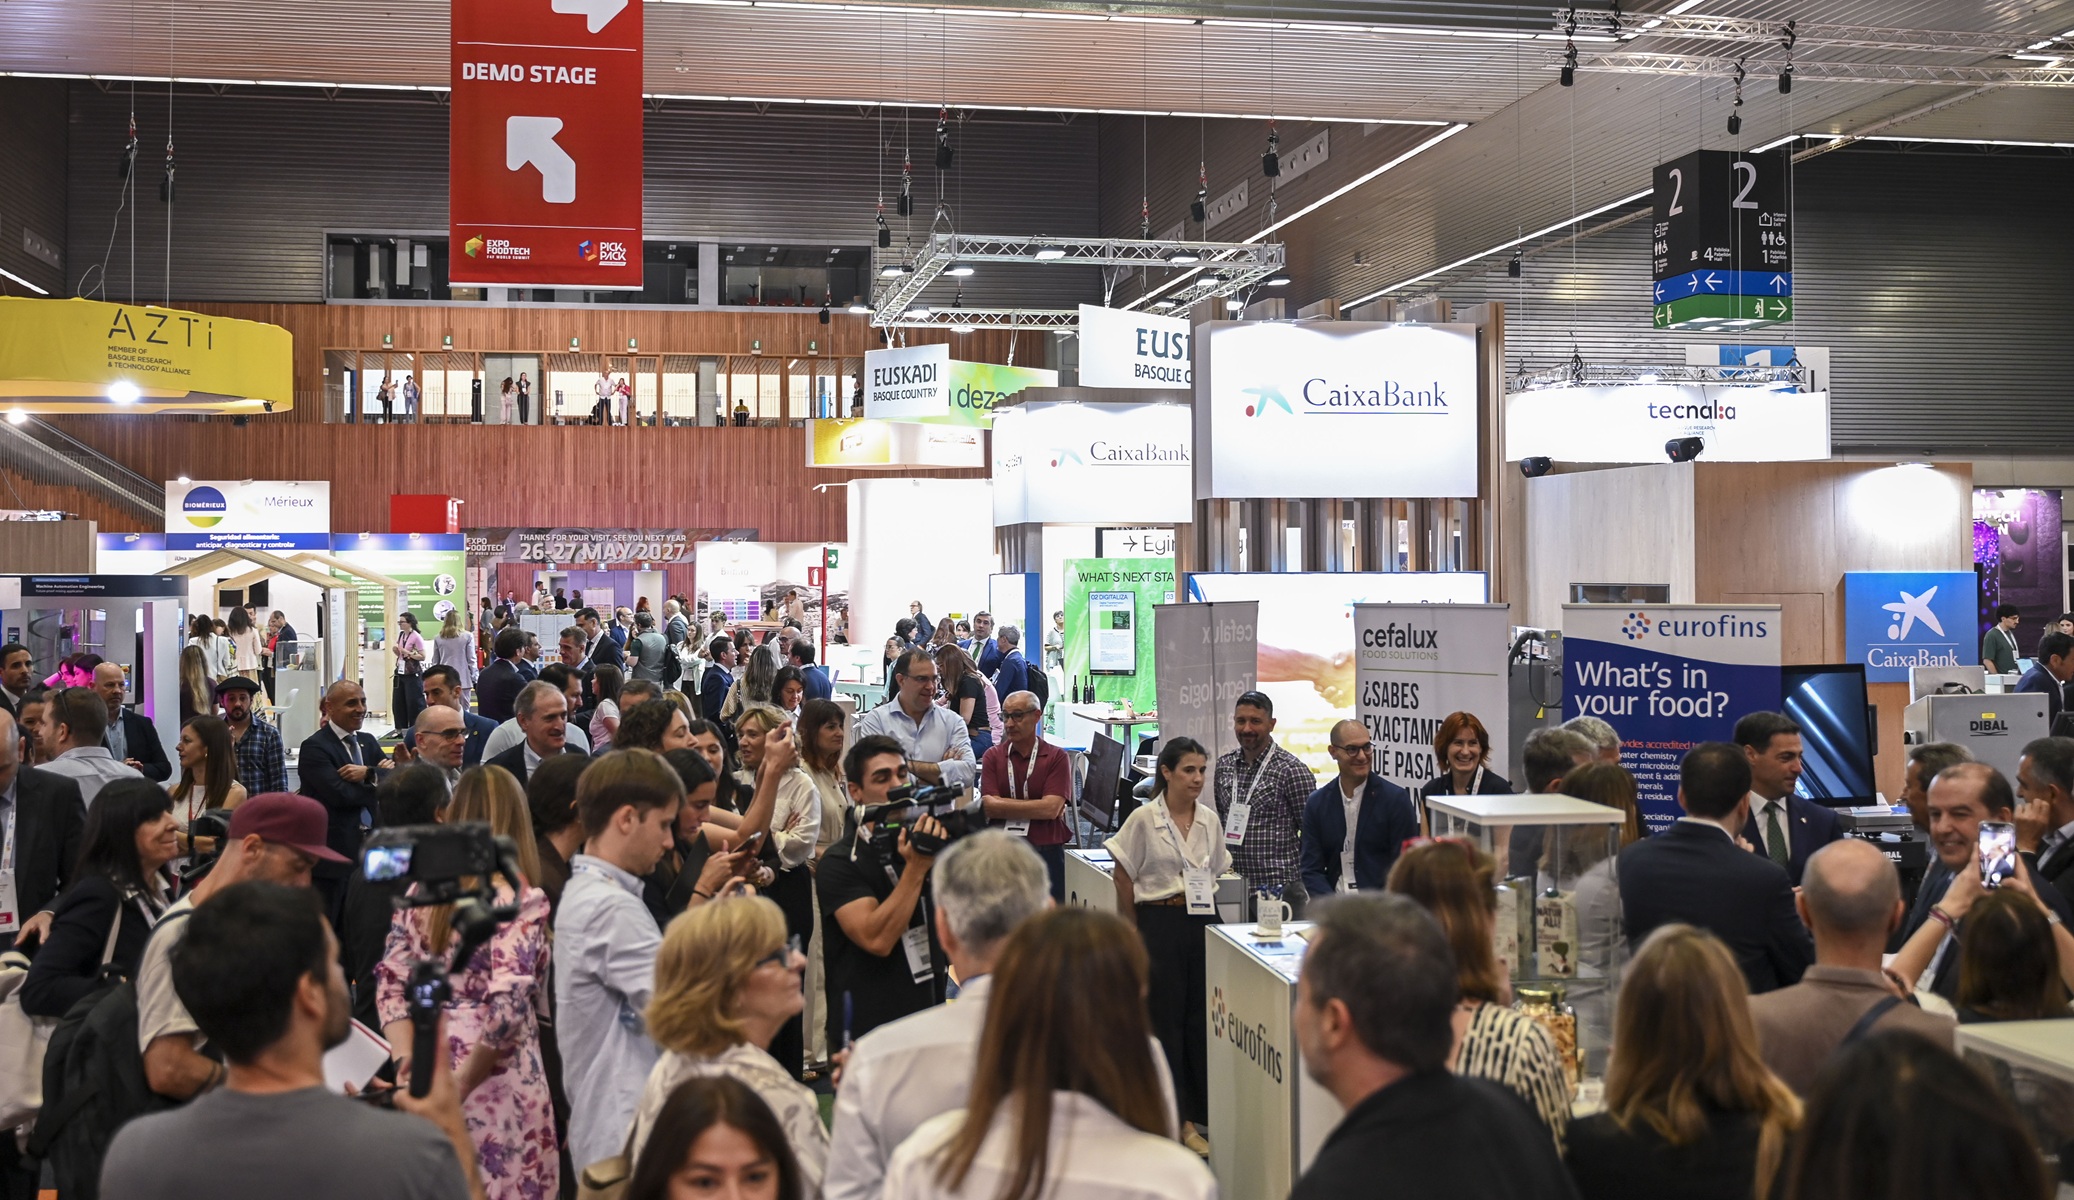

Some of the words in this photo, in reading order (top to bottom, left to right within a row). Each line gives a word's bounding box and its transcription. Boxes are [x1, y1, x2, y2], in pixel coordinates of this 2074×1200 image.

[462, 62, 525, 82] DEMO
[530, 65, 597, 85] STAGE
[1668, 168, 1683, 217] 2
[1732, 161, 1759, 210] 2
[486, 239, 510, 248] EXPO
[600, 241, 623, 252] PICK
[486, 247, 531, 256] FOODTECH
[600, 251, 627, 261] PACK
[1703, 247, 1714, 262] 4
[1762, 249, 1768, 264] 1
[107, 345, 137, 354] MEMBER
[107, 353, 136, 362] BASQUE
[137, 356, 172, 365] RESEARCH
[114, 361, 160, 372] TECHNOLOGY
[160, 367, 191, 376] ALLIANCE
[873, 363, 937, 387] EUSKADI
[1134, 363, 1182, 383] BASQUE
[873, 390, 900, 402] BASQUE
[901, 387, 938, 399] COUNTRY
[1302, 378, 1449, 407] CaixaBank
[1090, 441, 1191, 462] CaixaBank
[184, 501, 226, 509] BIOMÉRIEUX
[264, 496, 314, 507] Mérieux
[209, 534, 242, 542] Seguridad
[267, 541, 296, 549] controlar
[518, 534, 551, 542] THANKS
[551, 534, 568, 542] FOR
[568, 534, 590, 542] YOUR
[612, 534, 627, 542] SEE
[627, 534, 644, 542] YOU
[644, 534, 665, 542] NEXT
[519, 542, 577, 560] 26-27
[581, 542, 631, 560] MAY
[637, 543, 686, 560] 2027
[1122, 571, 1152, 583] NEXT
[1658, 614, 1767, 639] eurofins
[1363, 622, 1438, 649] cefalux
[1362, 650, 1387, 659] FOOD
[1388, 651, 1439, 661] SOLUTIONS
[1866, 648, 1960, 668] CaixaBank
[1682, 663, 1708, 689] in
[1362, 681, 1419, 710] ¿SABES
[1574, 694, 1639, 717] your
[1648, 690, 1729, 718] food?
[1969, 719, 2008, 731] DIBAL
[1646, 740, 1691, 750] accredited
[1640, 751, 1677, 761] chemistry
[1395, 751, 1435, 780] PASA
[1655, 772, 1661, 780] &
[1636, 792, 1643, 800] &
[1644, 792, 1673, 801] residues
[1228, 1009, 1283, 1084] eurofins
